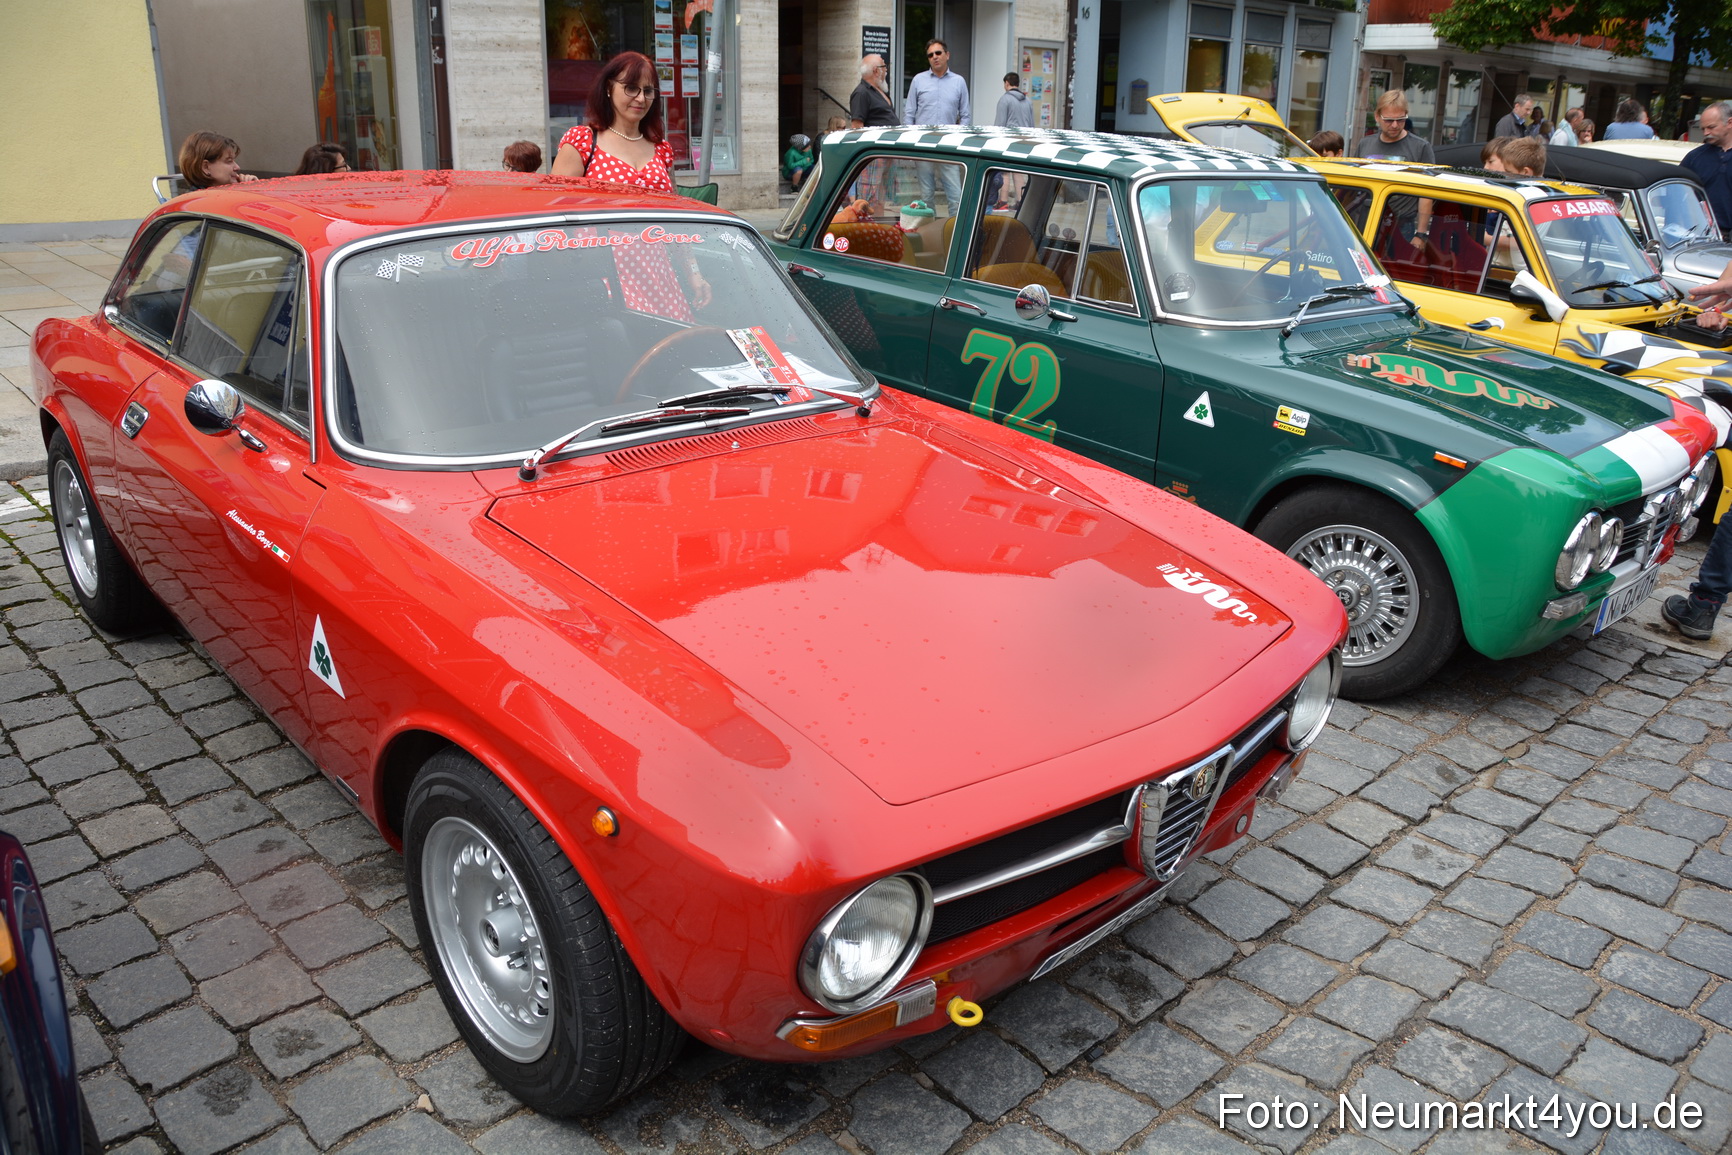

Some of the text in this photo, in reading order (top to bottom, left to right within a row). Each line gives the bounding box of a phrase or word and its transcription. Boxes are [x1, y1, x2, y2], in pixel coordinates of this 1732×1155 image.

[1081, 6, 1091, 20] 16
[1566, 201, 1619, 216] ABARTH
[450, 235, 534, 268] Alfa
[535, 228, 640, 252] Romeo
[836, 239, 849, 250] STP
[1305, 250, 1333, 264] Satiro
[961, 327, 1061, 444] 72
[1291, 413, 1306, 423] Agip
[1279, 424, 1304, 434] DUNLOP
[226, 509, 257, 536] Alessandro
[1605, 593, 1620, 625] N
